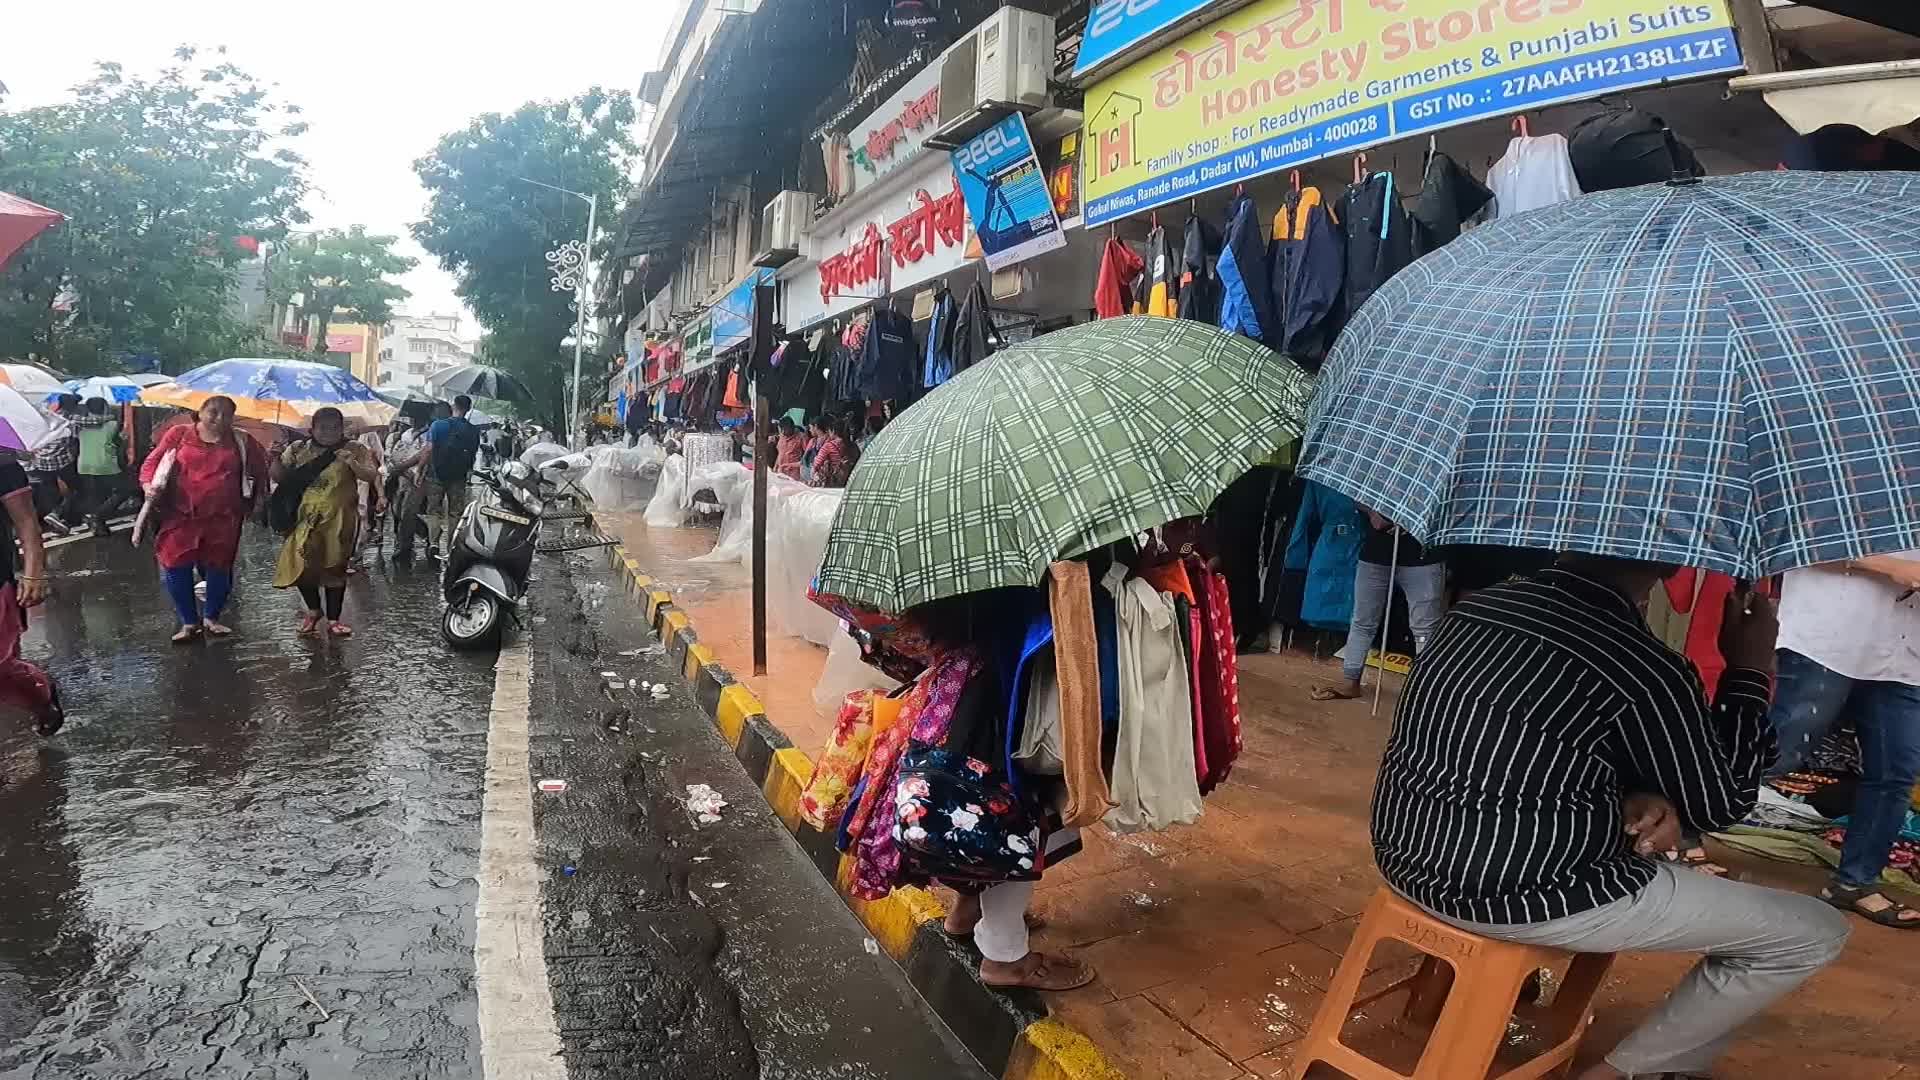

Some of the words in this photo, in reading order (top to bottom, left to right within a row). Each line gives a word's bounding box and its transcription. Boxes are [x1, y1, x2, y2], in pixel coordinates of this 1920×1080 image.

[892, 16, 937, 27] magicpin
[1147, 150, 1184, 172] Family
[1187, 138, 1219, 160] Shop
[1232, 126, 1255, 144] For
[1260, 89, 1359, 135] Readymade
[1366, 57, 1472, 99] Garments
[1481, 47, 1501, 68] &
[1510, 18, 1618, 61] Punjabi
[1628, 5, 1711, 34] Suits
[1201, 40, 1367, 127] Honesty
[1409, 97, 1443, 119] GST
[1447, 92, 1474, 110] No
[1502, 37, 1727, 97] 27AAAFH2138L1ZF
[1088, 201, 1110, 218] Gokul
[1138, 182, 1170, 202] Ranade
[1172, 170, 1199, 192] Road,
[1201, 160, 1231, 181] Dadar
[1234, 151, 1259, 173] (W),
[1261, 133, 1313, 162] Mumbai
[1323, 115, 1378, 142] 400028
